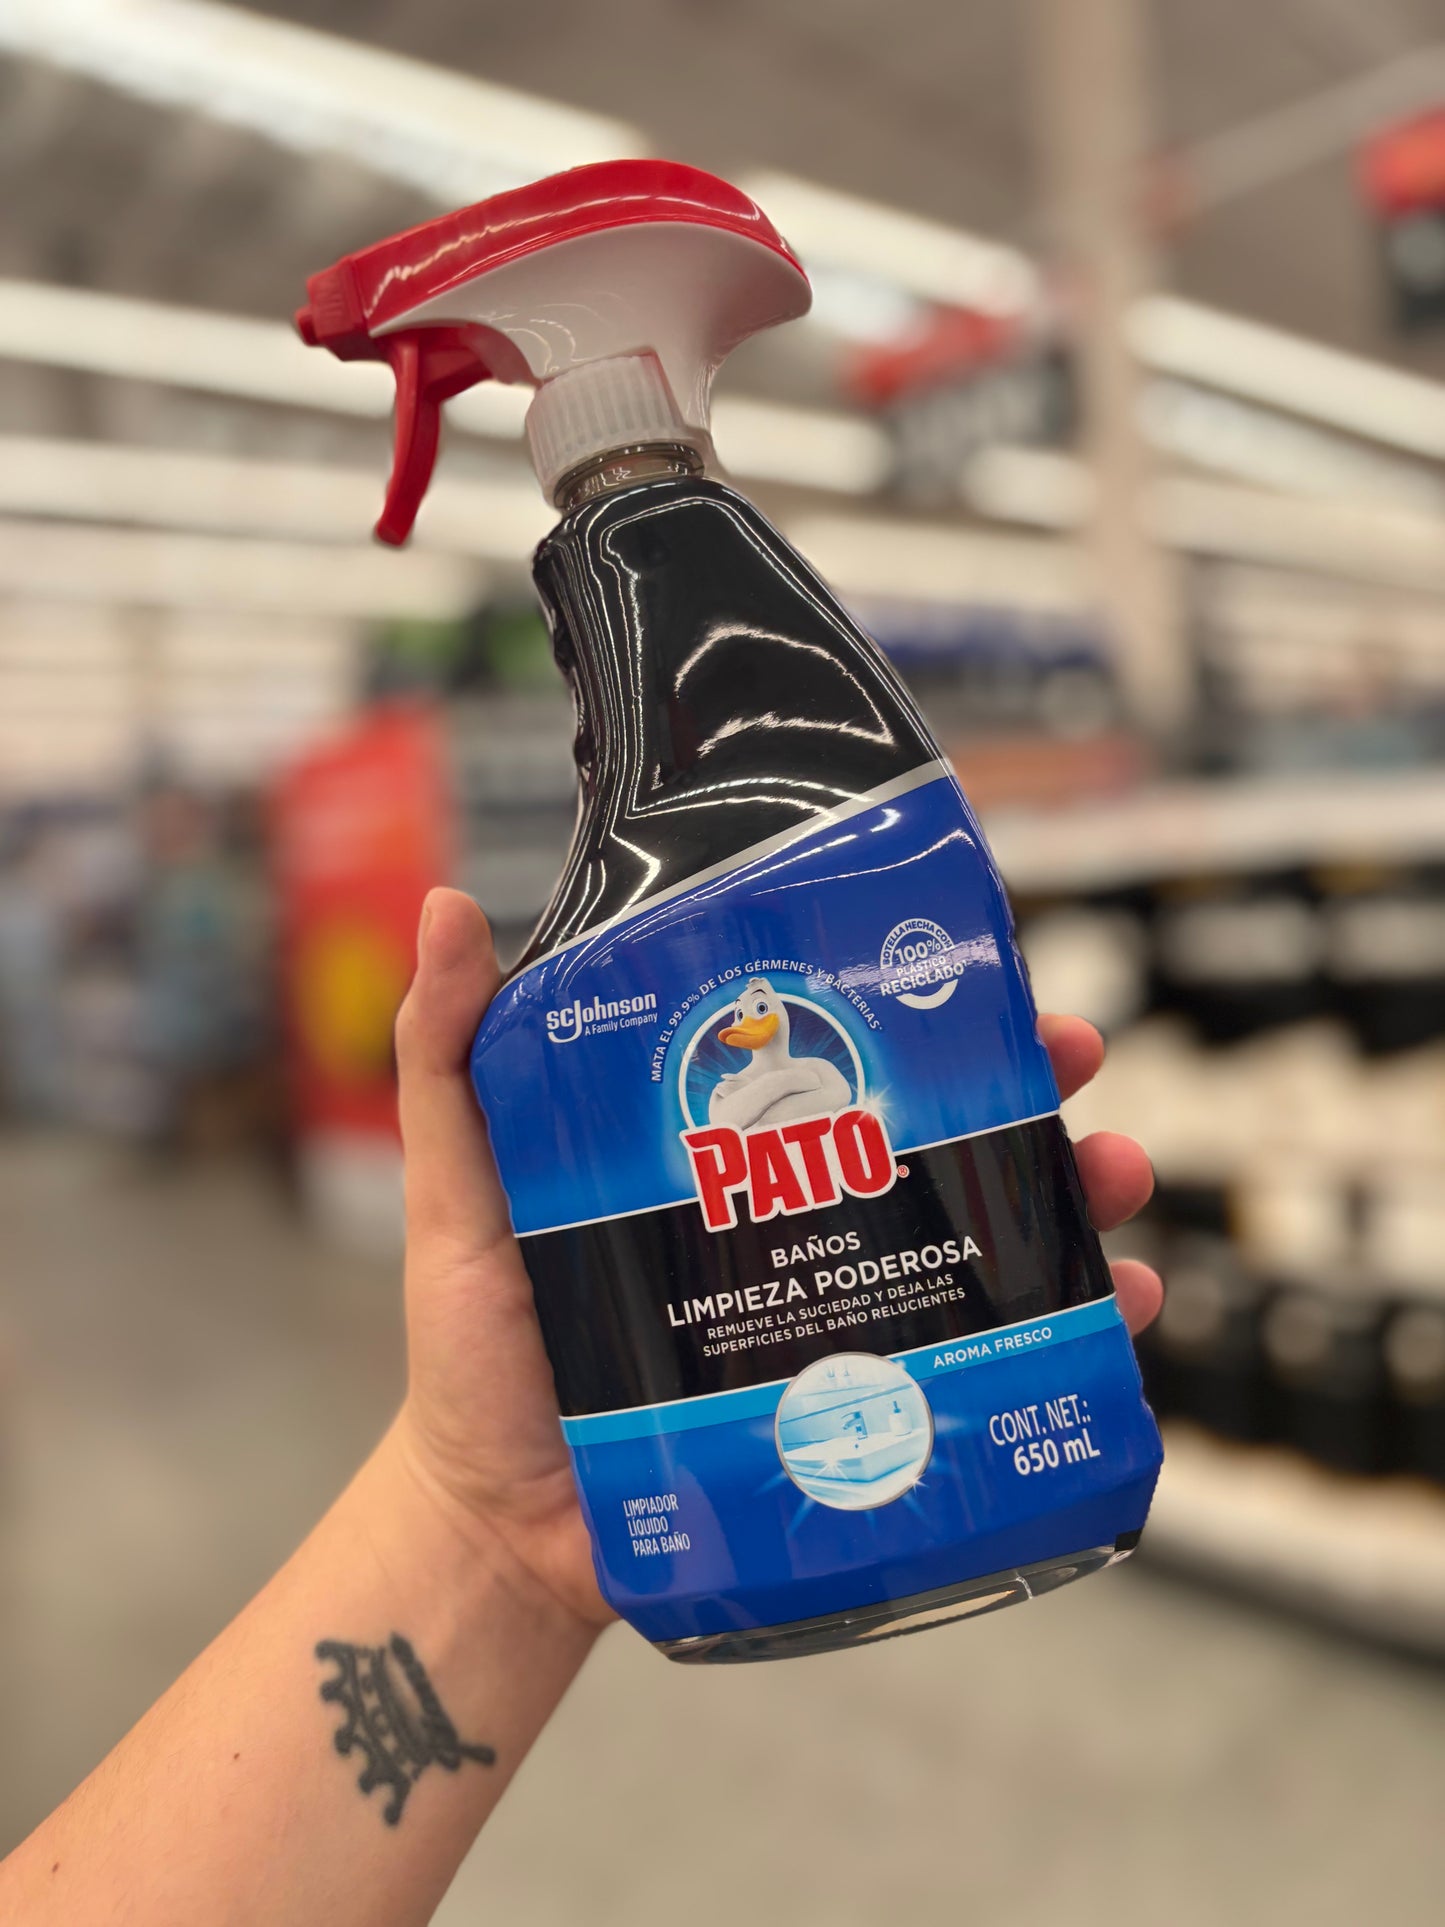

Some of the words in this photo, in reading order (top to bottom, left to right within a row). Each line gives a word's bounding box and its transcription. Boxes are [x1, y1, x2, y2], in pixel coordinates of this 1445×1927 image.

[881, 926, 906, 966] BOTELLA
[904, 920, 935, 933] HECHA
[935, 928, 953, 950] CON
[895, 938, 941, 964] 100%
[585, 1026, 591, 1036] A
[592, 1018, 618, 1034] Family
[619, 1012, 658, 1028] Company
[651, 1046, 666, 1081] MATA
[659, 1029, 674, 1043] EL
[668, 993, 700, 1027] 99.9%
[699, 978, 717, 995] DE
[717, 965, 742, 984] LOS
[744, 958, 814, 975] GÉRMENES
[815, 968, 825, 979] Y
[684, 1109, 893, 1228] PATO
[770, 1231, 861, 1269] BAÑOS
[666, 1277, 808, 1327] LIMPIEZA
[814, 1235, 983, 1296] PODEROSA
[703, 1328, 793, 1357] SUPERFICIES
[795, 1322, 824, 1338] DEL
[826, 1311, 868, 1331] BAÑO
[871, 1287, 966, 1320] RELUCIENTES
[707, 1315, 774, 1340] REMUEVE
[776, 1311, 796, 1325] LA
[798, 1294, 871, 1320] SUCIEDAD
[874, 1290, 883, 1302] Y
[887, 1281, 925, 1300] DEJA
[926, 1273, 954, 1290] LAS
[933, 1343, 993, 1369] AROMA
[994, 1327, 1053, 1352] FRESCO
[989, 1405, 1047, 1446] CONT.
[1045, 1393, 1092, 1432] NET.:
[1014, 1438, 1060, 1476] 650
[1063, 1428, 1101, 1464] mL
[623, 1493, 679, 1517] LIMPIADOR
[627, 1515, 669, 1537] LÍQUIDO
[632, 1537, 661, 1557] PARA
[660, 1531, 691, 1553] BAÑO
